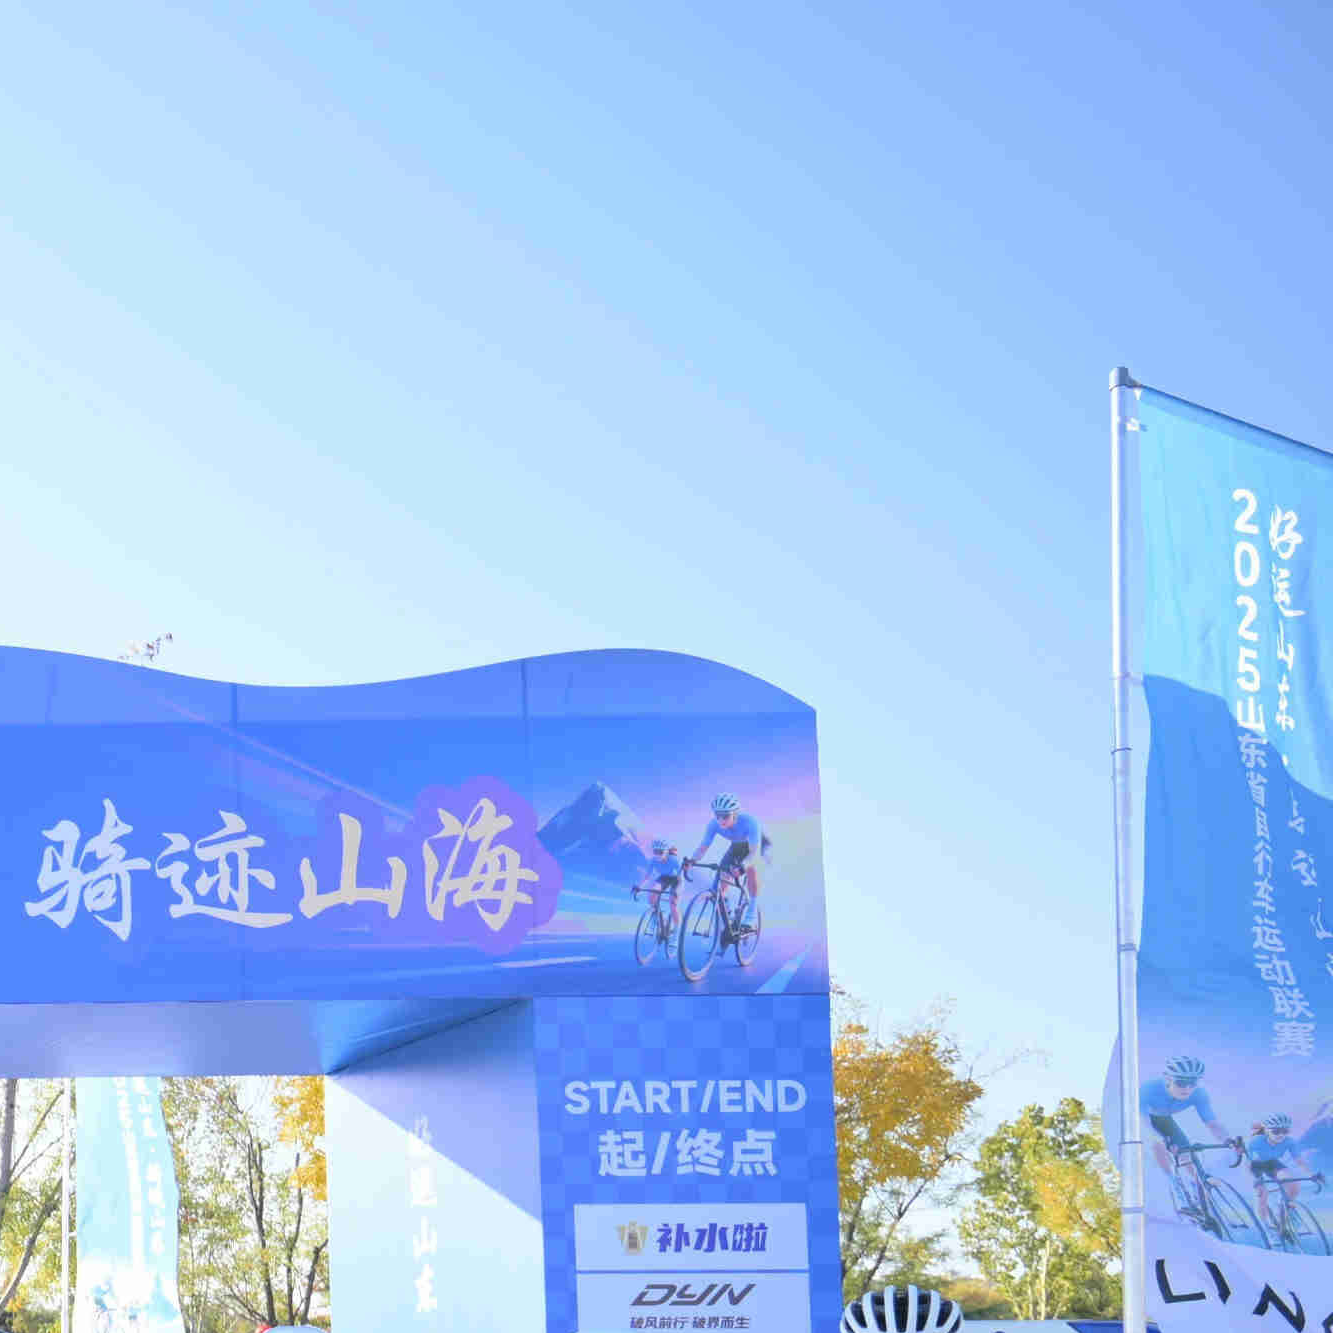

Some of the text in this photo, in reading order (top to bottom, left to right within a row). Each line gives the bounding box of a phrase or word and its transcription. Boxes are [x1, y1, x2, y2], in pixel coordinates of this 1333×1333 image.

[25, 797, 538, 942] 骑迹山海
[564, 1079, 808, 1115] START/END
[598, 1128, 778, 1177] 起/终点
[656, 1222, 769, 1253] 补水啦
[630, 1283, 756, 1307] DYN
